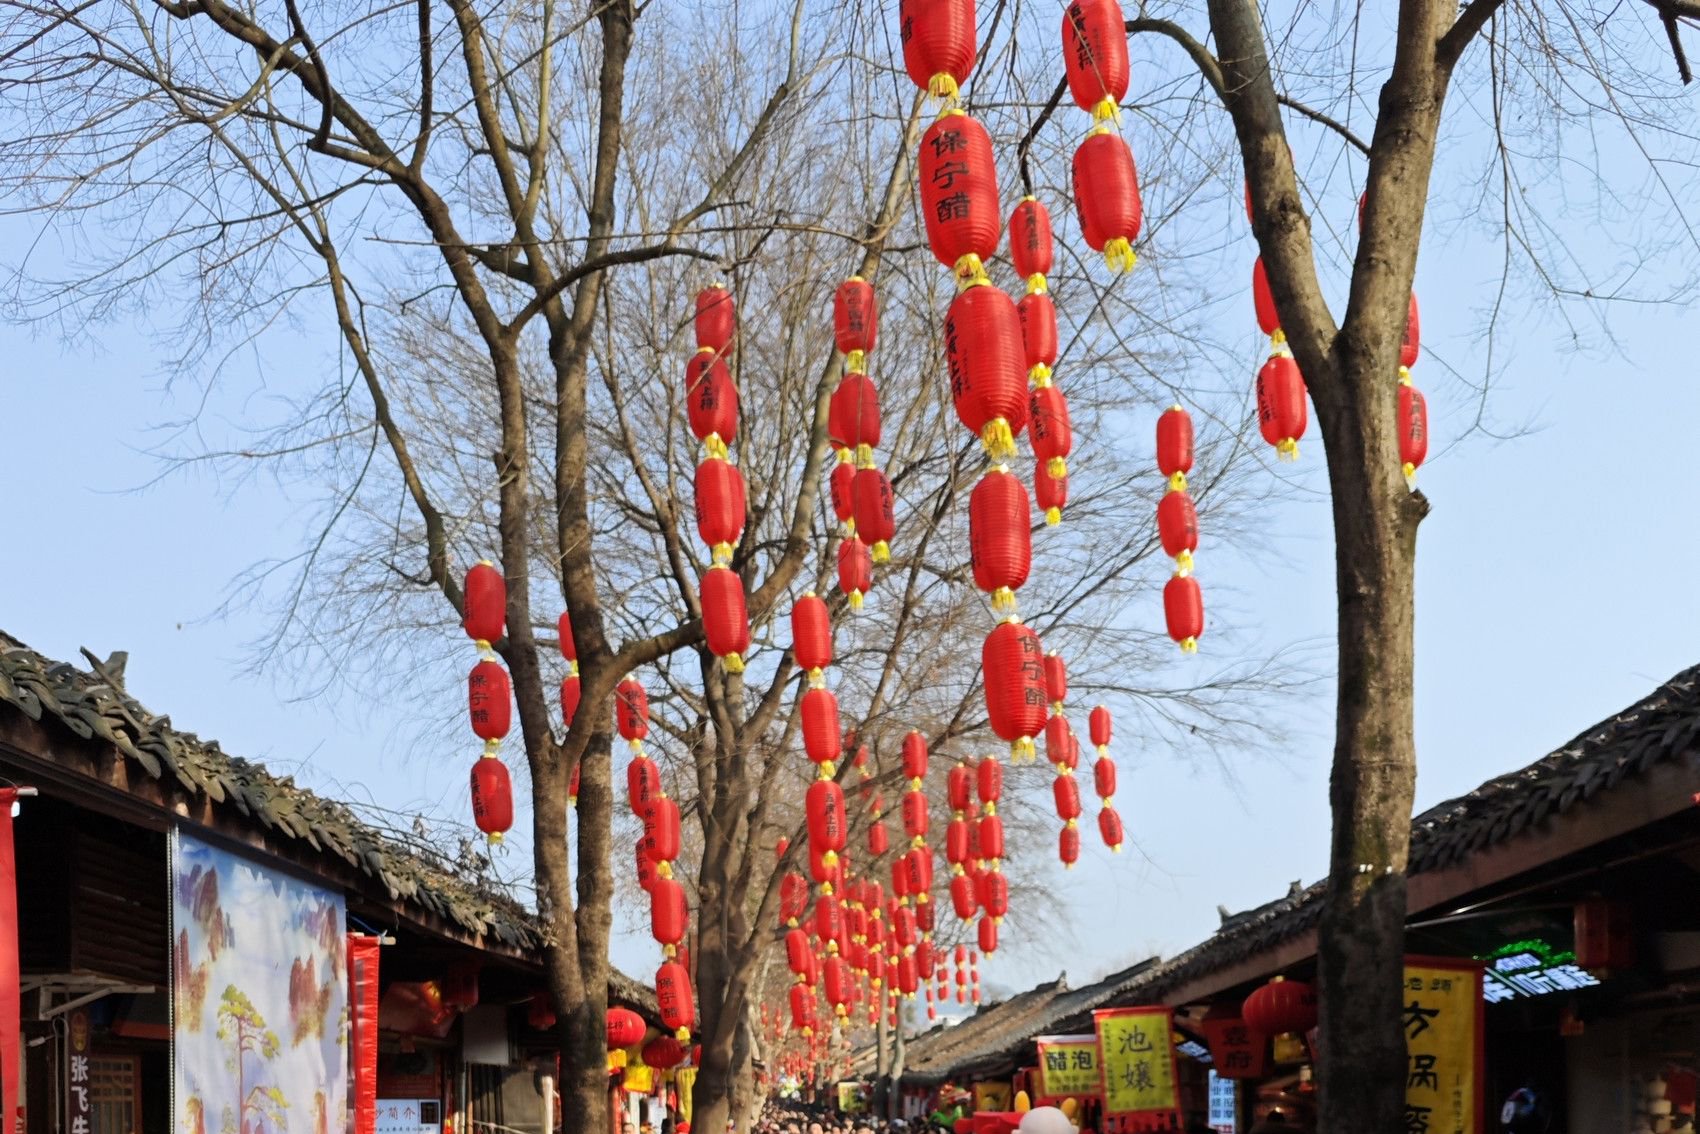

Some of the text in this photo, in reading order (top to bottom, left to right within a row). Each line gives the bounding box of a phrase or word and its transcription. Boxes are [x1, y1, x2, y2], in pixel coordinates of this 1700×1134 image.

[930, 129, 971, 224] 保宁醋
[470, 674, 488, 724] 保宁醋
[658, 977, 679, 1018] 保宁醋
[1047, 1049, 1093, 1072] 醋泡
